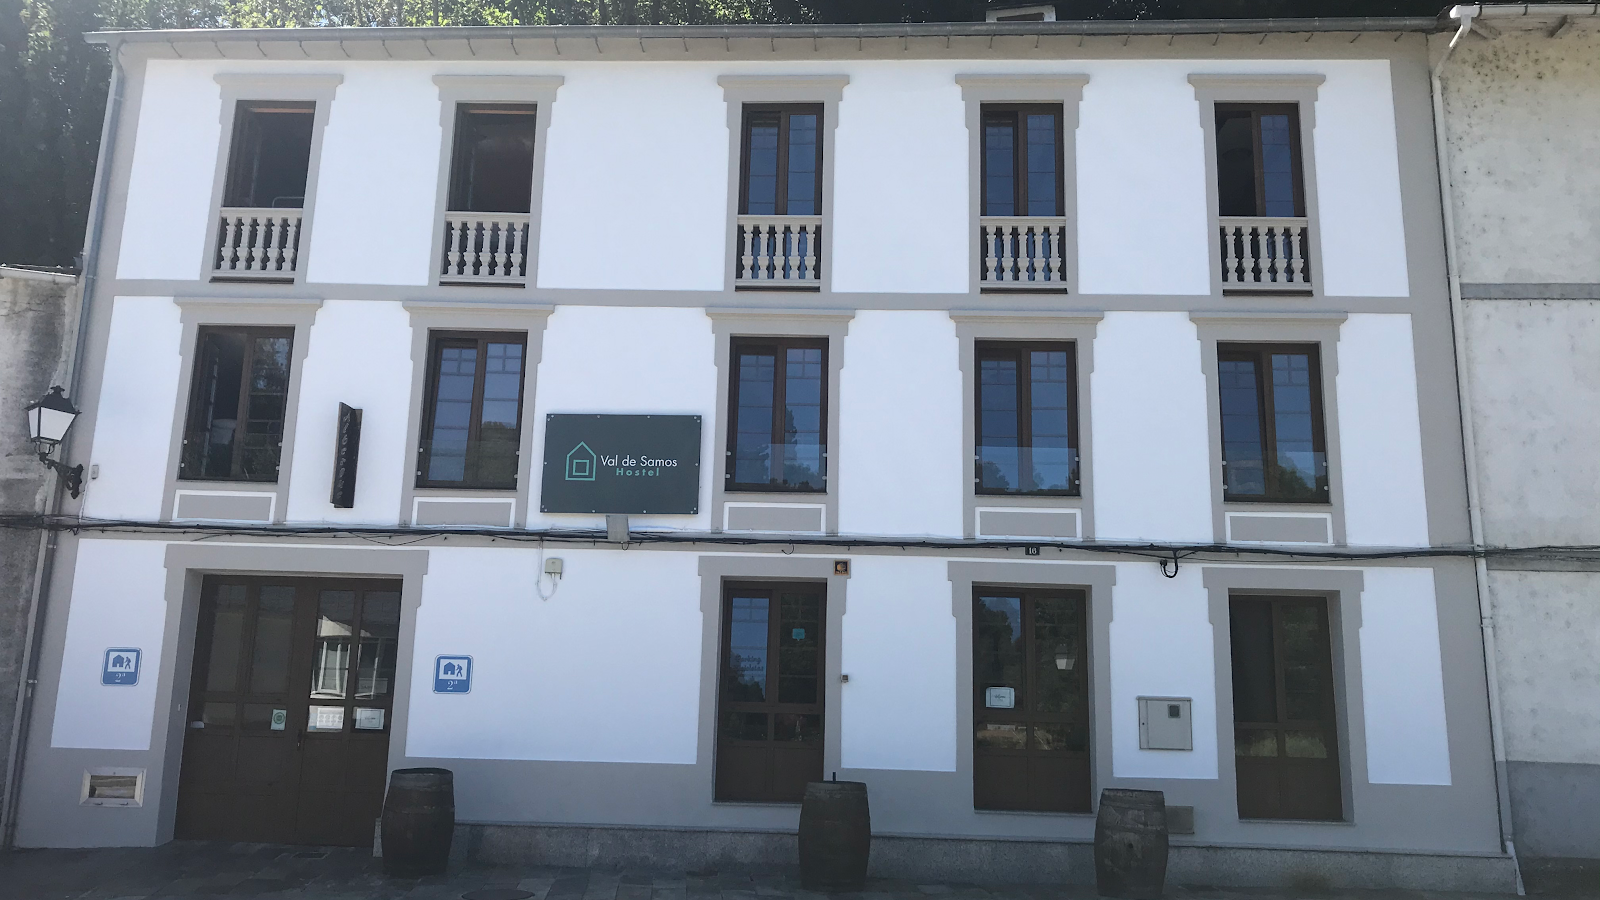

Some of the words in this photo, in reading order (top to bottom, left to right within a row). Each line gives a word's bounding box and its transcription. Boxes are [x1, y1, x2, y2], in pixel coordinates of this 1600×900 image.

[600, 454, 619, 467] Val
[622, 455, 637, 467] de
[640, 455, 678, 468] Samos
[616, 467, 660, 476] Hostel
